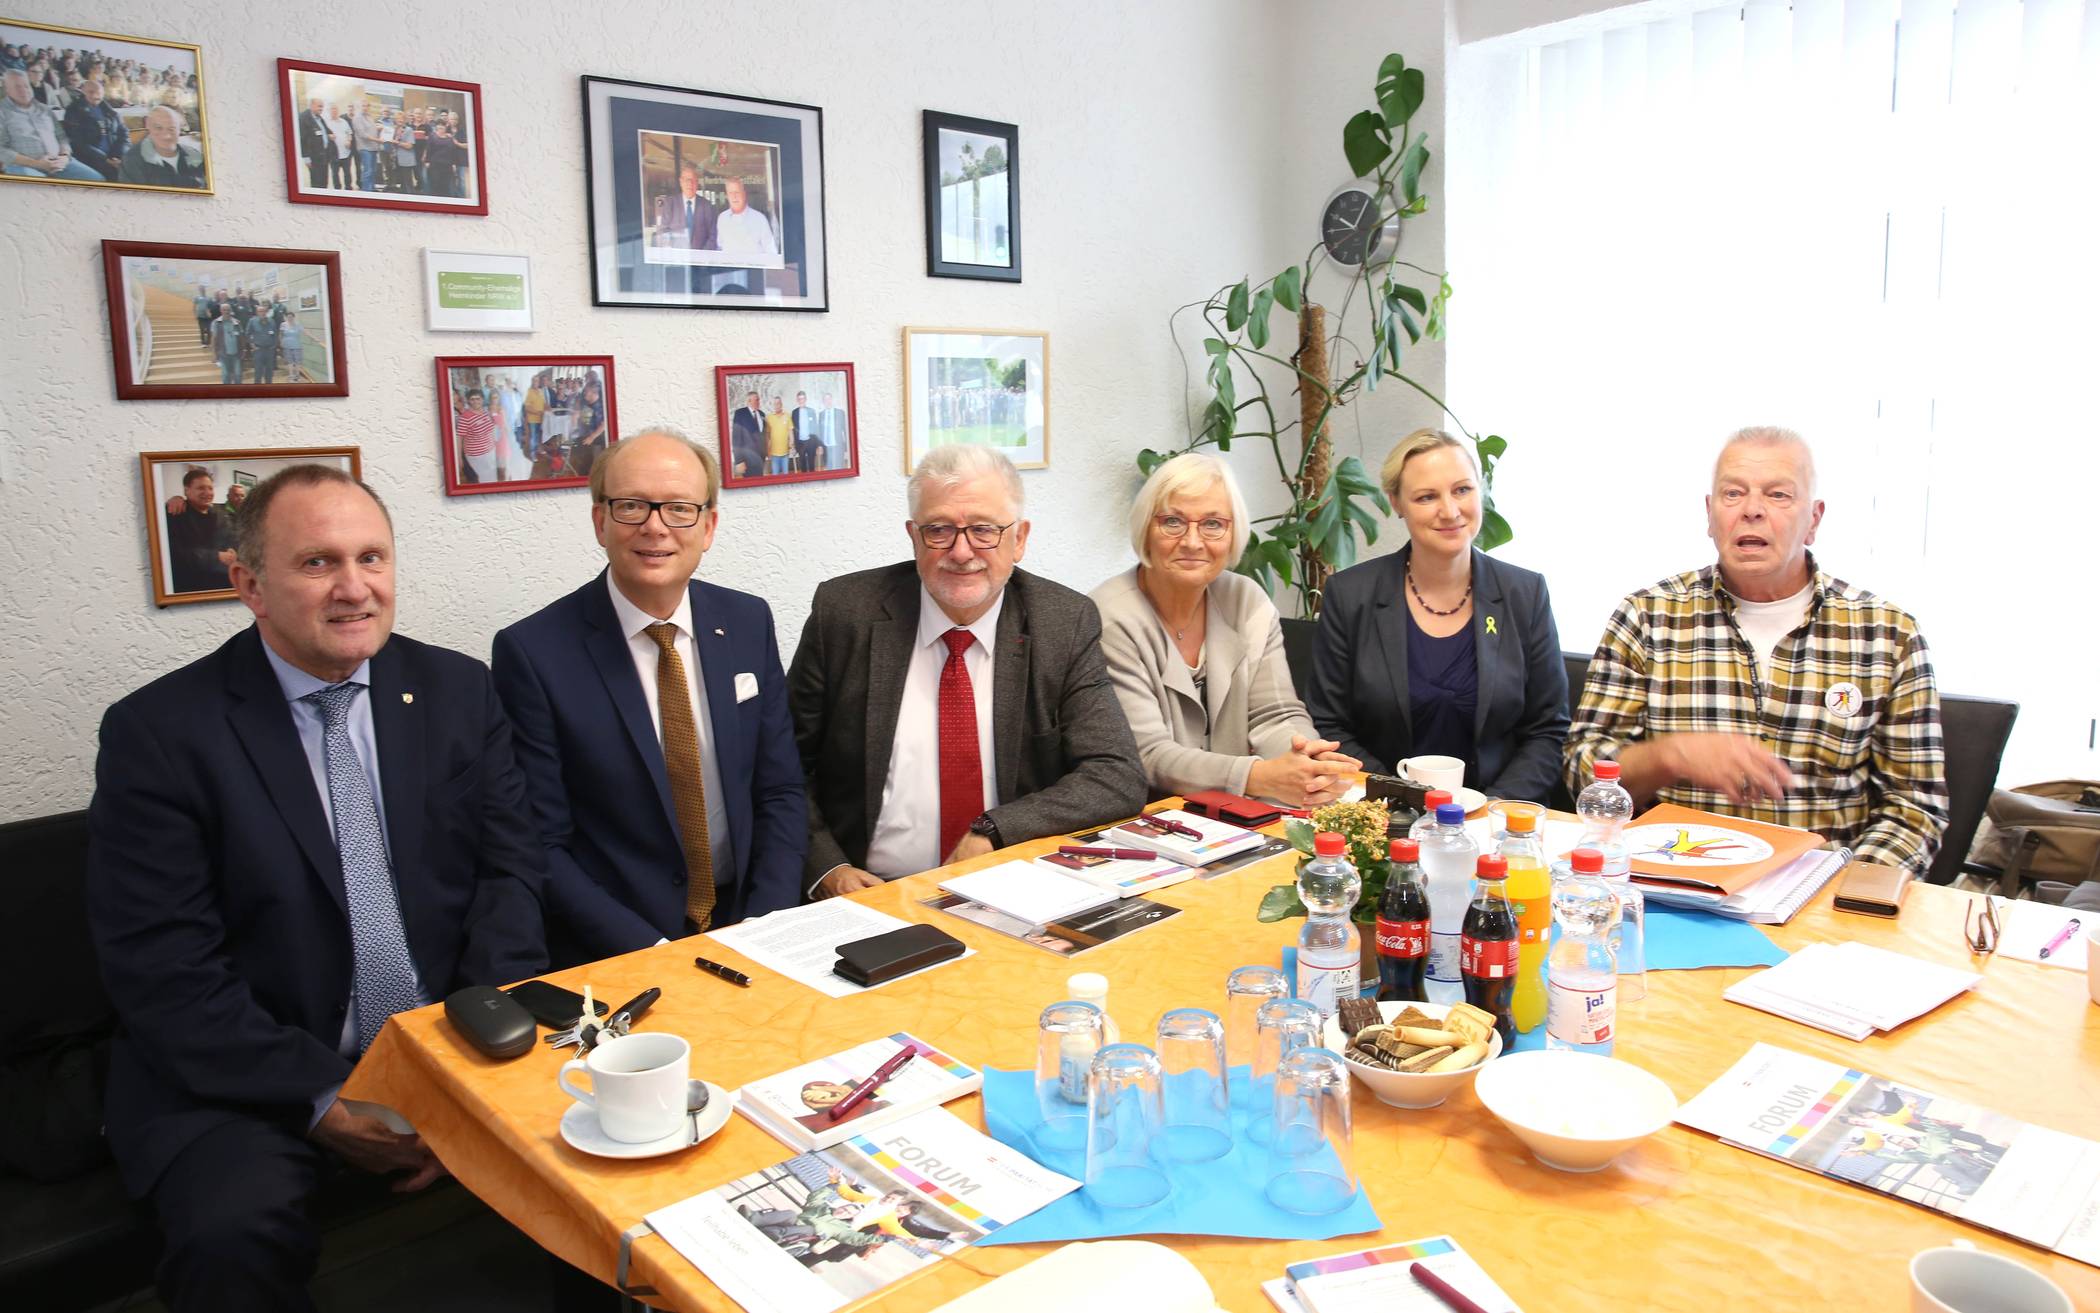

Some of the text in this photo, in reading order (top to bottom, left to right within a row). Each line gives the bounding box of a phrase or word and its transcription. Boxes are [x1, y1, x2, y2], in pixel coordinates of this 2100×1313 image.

[1585, 994, 1604, 1013] ja!
[1748, 1084, 1819, 1135] FORUM
[884, 1135, 982, 1196] FORUM
